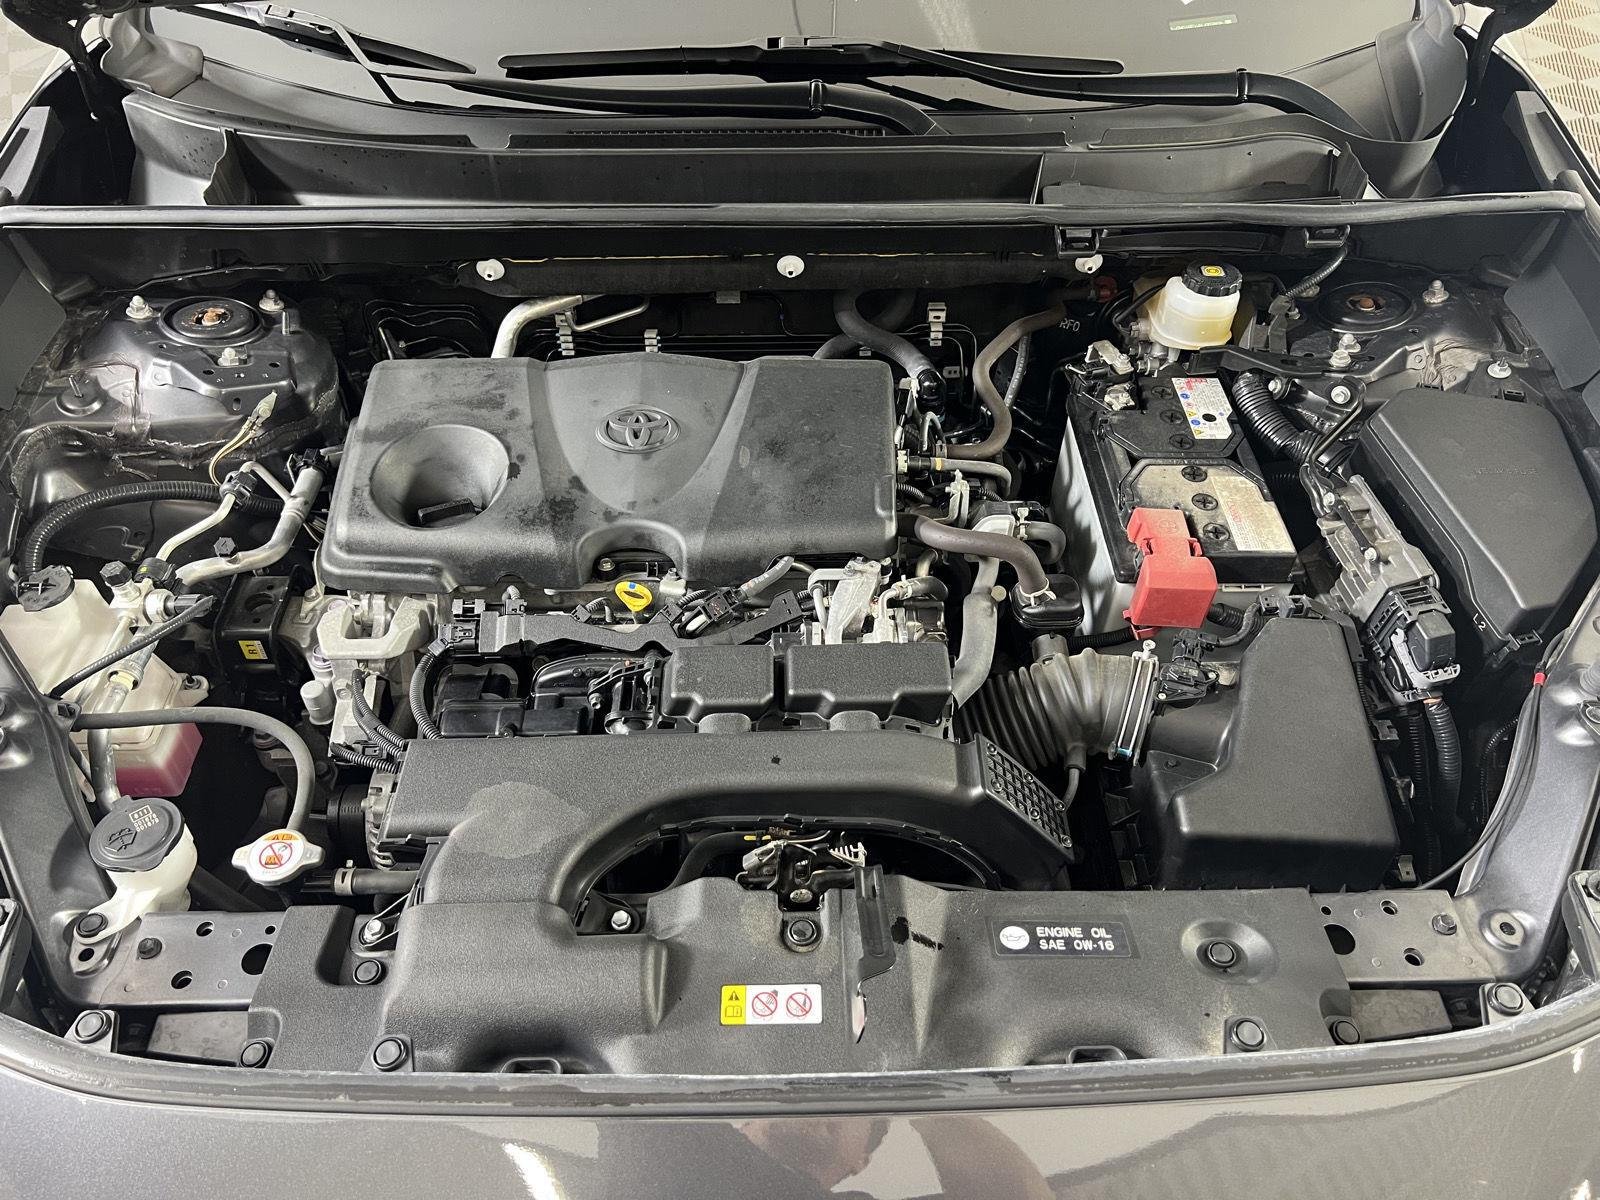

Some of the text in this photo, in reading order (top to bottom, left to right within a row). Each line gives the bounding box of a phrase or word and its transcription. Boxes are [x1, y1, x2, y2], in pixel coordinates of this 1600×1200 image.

[1035, 926, 1112, 939] ENGINE OIL
[1039, 939, 1066, 951] SAE
